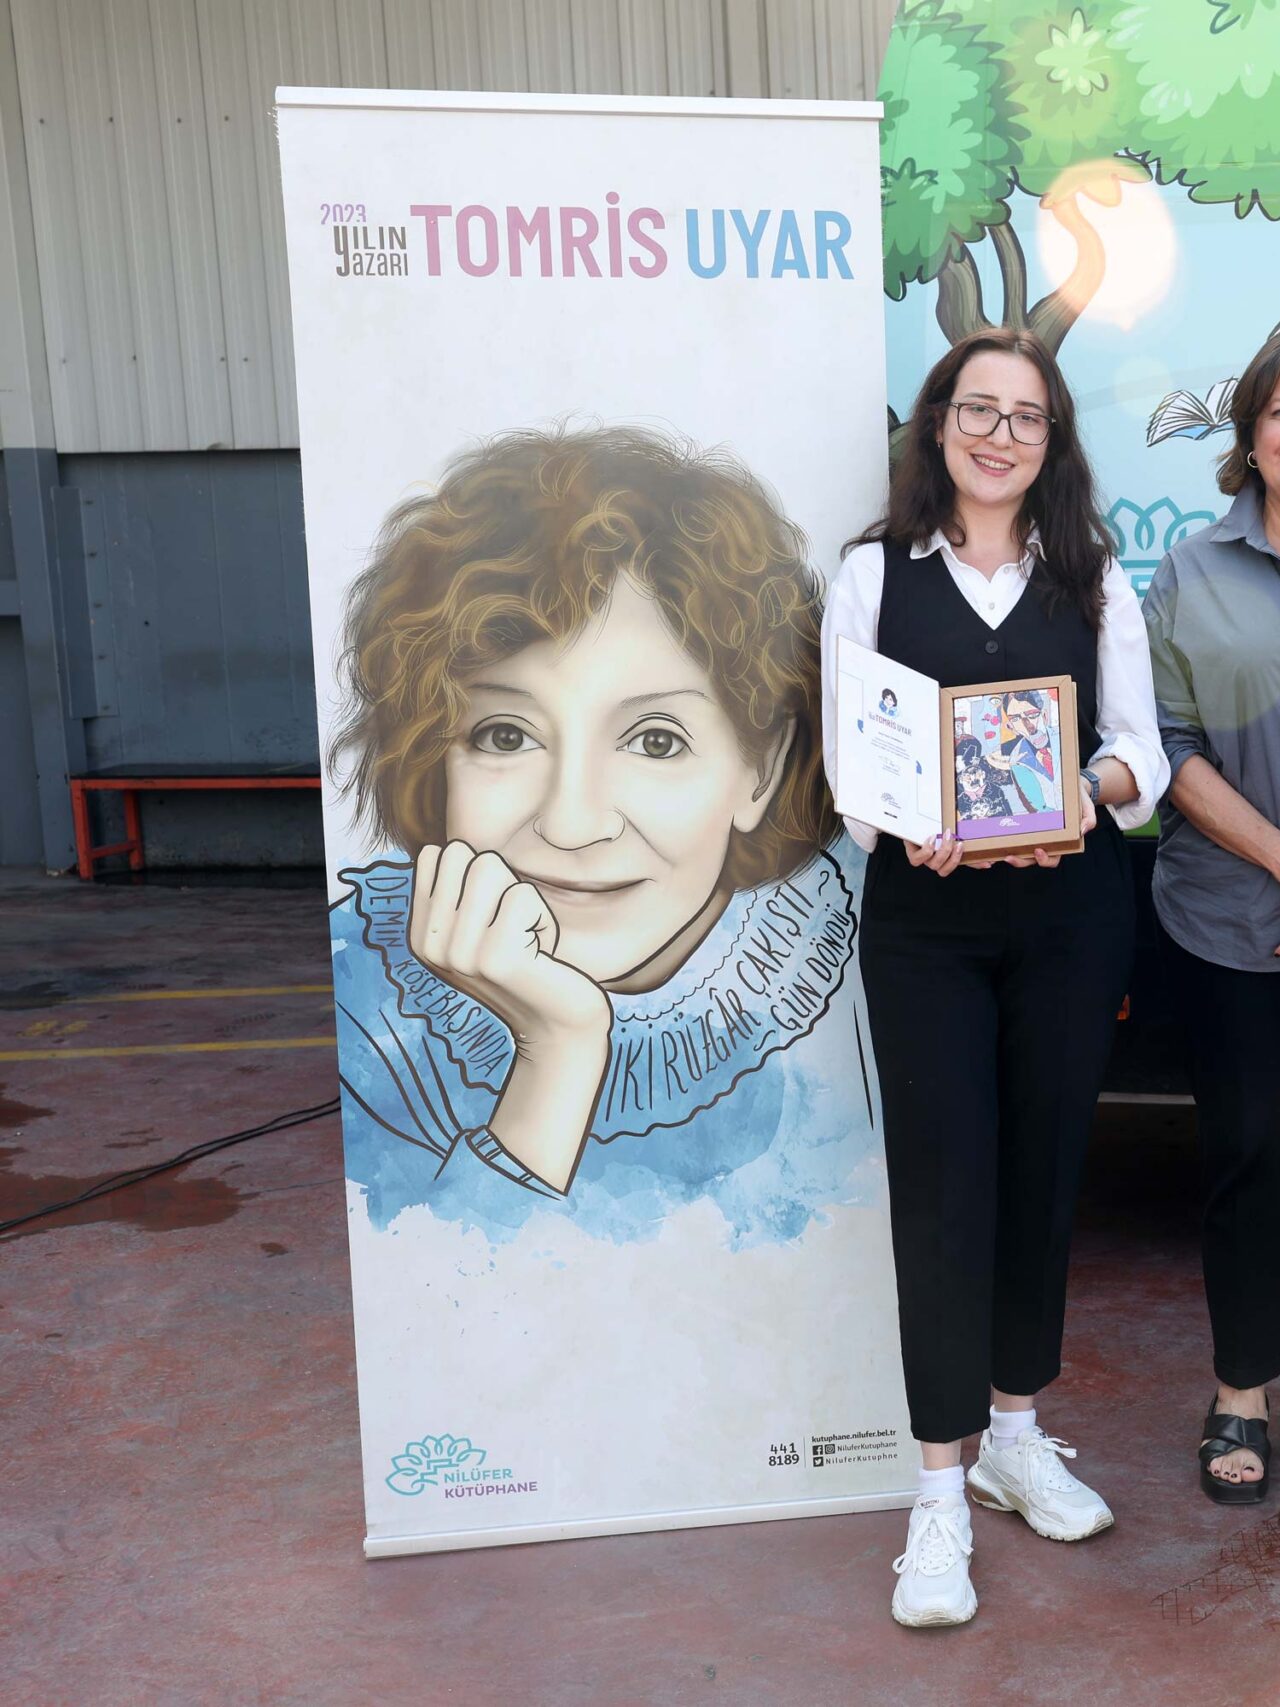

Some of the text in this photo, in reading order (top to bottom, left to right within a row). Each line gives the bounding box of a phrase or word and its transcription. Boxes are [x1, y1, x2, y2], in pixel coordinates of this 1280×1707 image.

[320, 203, 367, 225] 2023
[410, 191, 855, 280] TOMRİS UYAR
[770, 903, 851, 1031] GÜN DÖNDÜ
[365, 877, 510, 1078] DEMİN KÖŞEBAŞINDA
[606, 880, 814, 1122] İKİ RÜZGÂR ÇAKIŞTI
[812, 1430, 896, 1443] kutuphane.nilufer.bel.tr
[837, 1441, 897, 1452] NiluferKutuphane
[768, 1454, 800, 1466] 8189
[444, 1468, 513, 1483] NİLÜFER
[444, 1481, 538, 1499] KÜTÜPHANE
